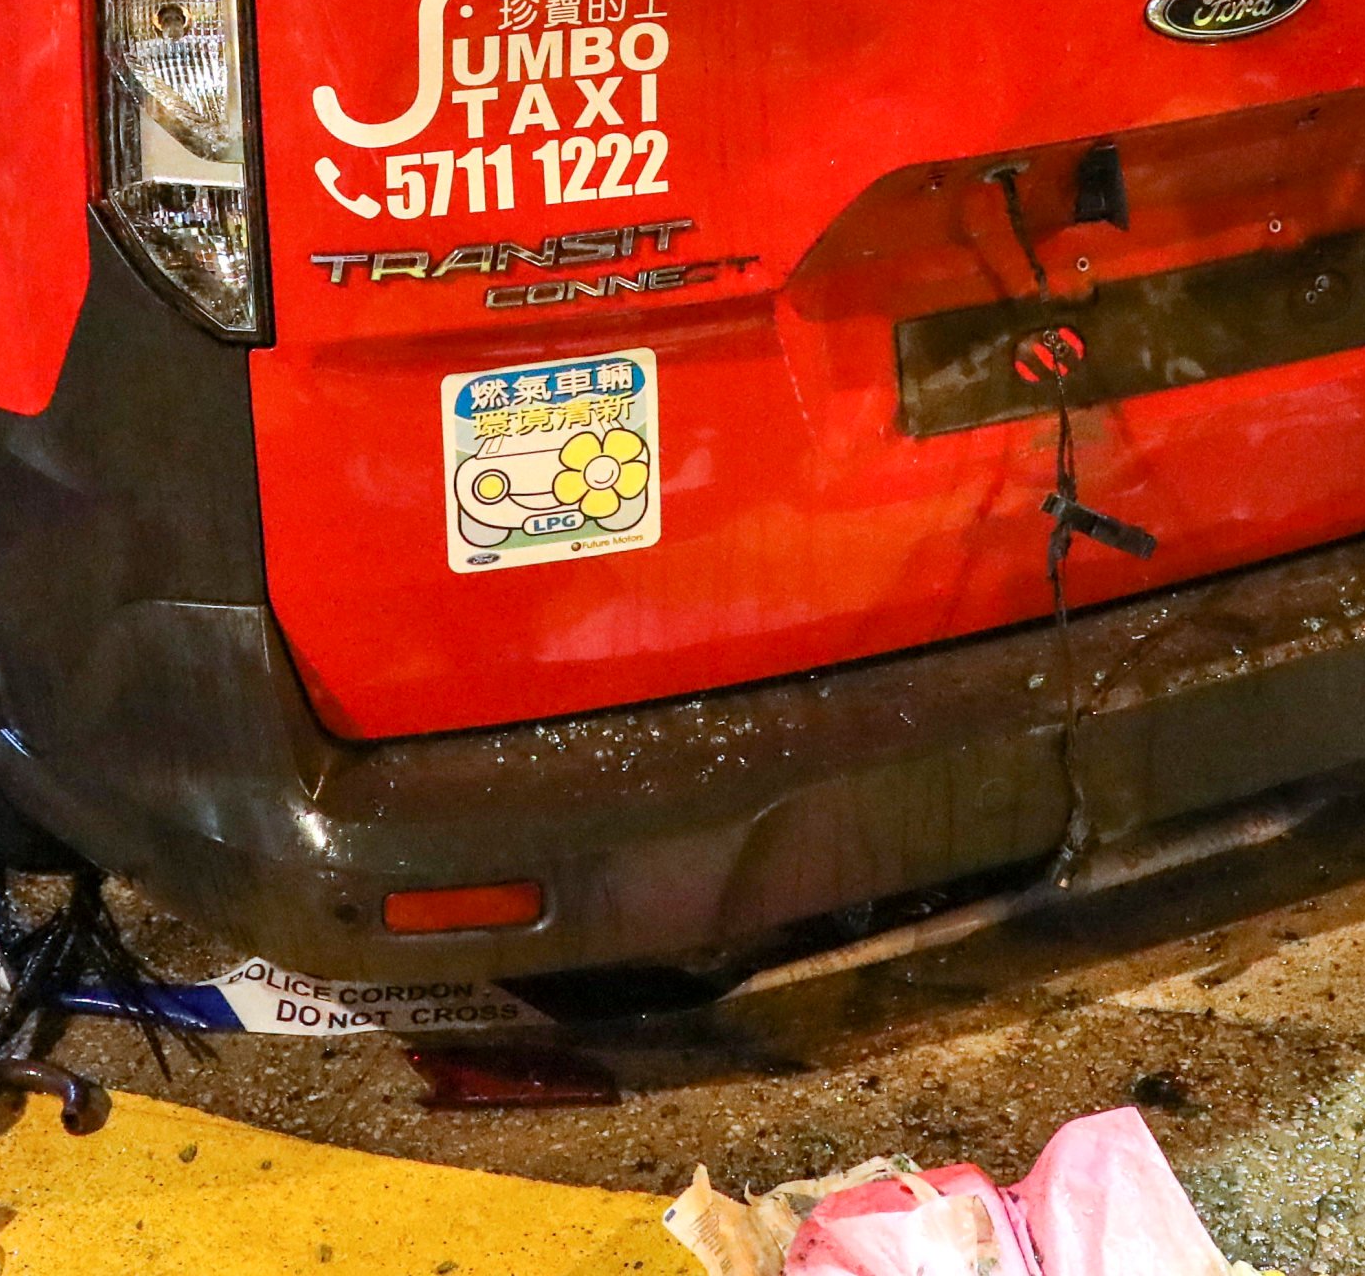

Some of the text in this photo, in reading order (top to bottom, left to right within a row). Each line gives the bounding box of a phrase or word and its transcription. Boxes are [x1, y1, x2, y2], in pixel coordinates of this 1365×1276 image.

[451, 73, 657, 139] TAXI
[386, 130, 669, 220] 5711 1222
[310, 219, 693, 283] TRANSIT
[470, 361, 634, 411] 燃氣車輛
[472, 392, 635, 440] 環境清新
[533, 514, 577, 533] LPG
[581, 533, 645, 551] Future Motors
[228, 963, 474, 1004] POLICE CORDON
[276, 998, 519, 1029] DO NOT CROSS
